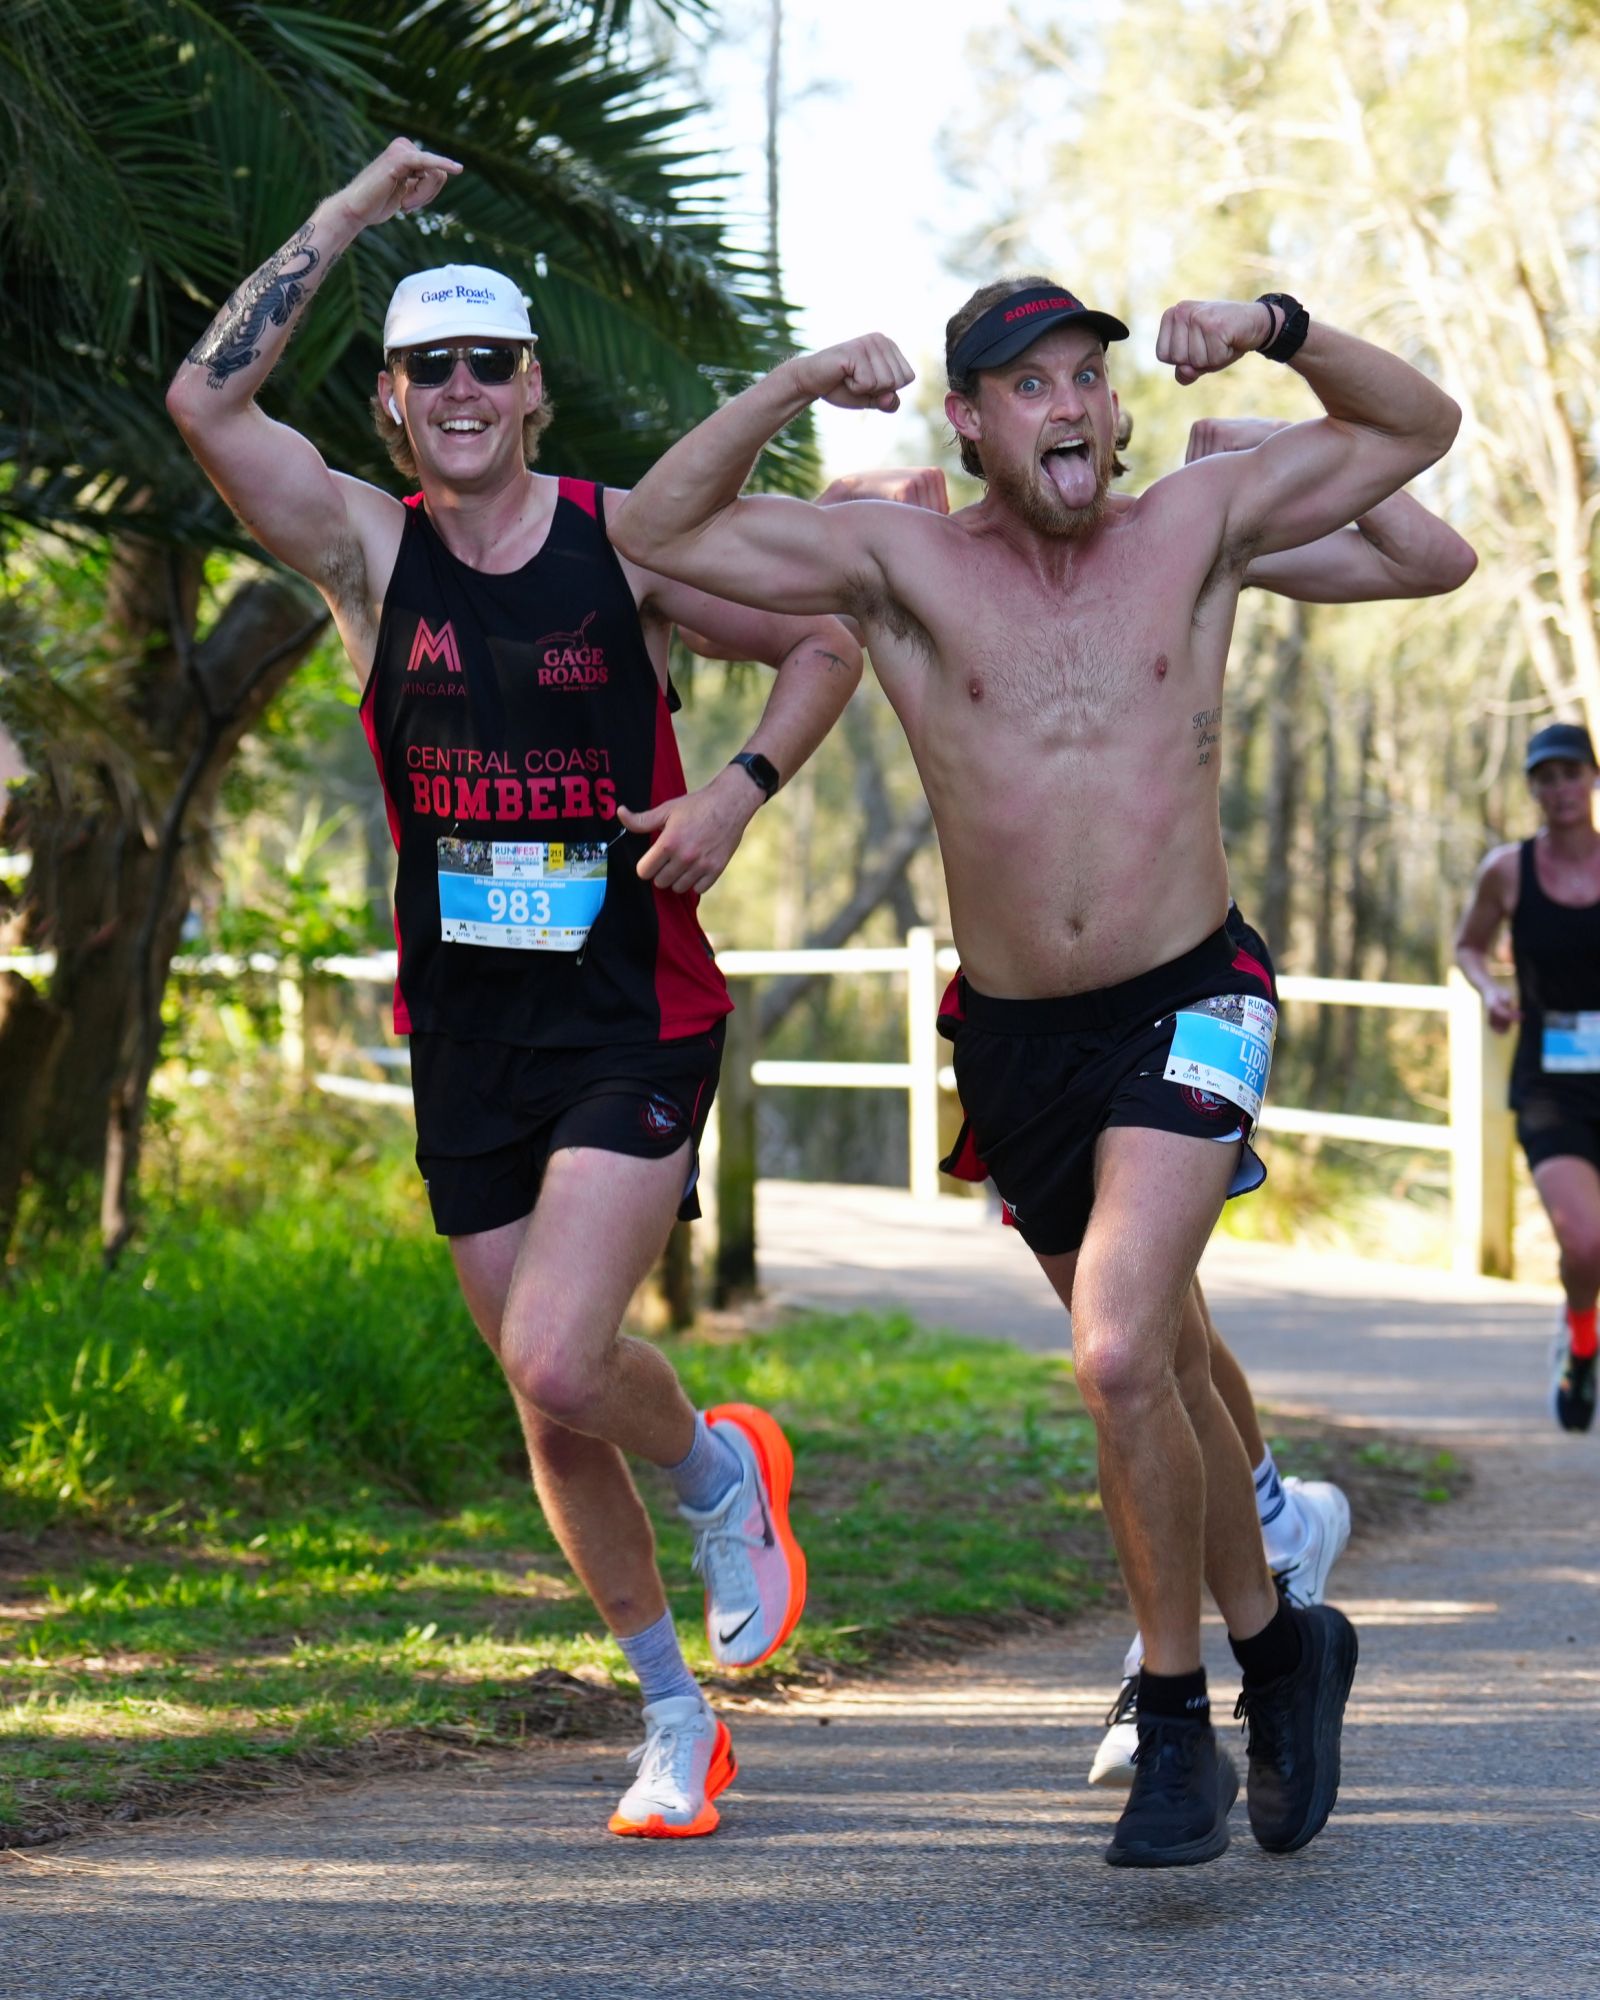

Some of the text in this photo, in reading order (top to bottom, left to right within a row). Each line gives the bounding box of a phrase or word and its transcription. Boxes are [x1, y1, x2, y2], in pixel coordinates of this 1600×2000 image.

[421, 285, 496, 304] Gage Roads
[543, 647, 604, 667] GAGE
[538, 667, 609, 686] ROADS
[406, 745, 611, 774] CENTRAL COAST
[408, 772, 617, 822] BOMBERS
[487, 888, 551, 925] 983
[1244, 1066, 1259, 1089] 721
